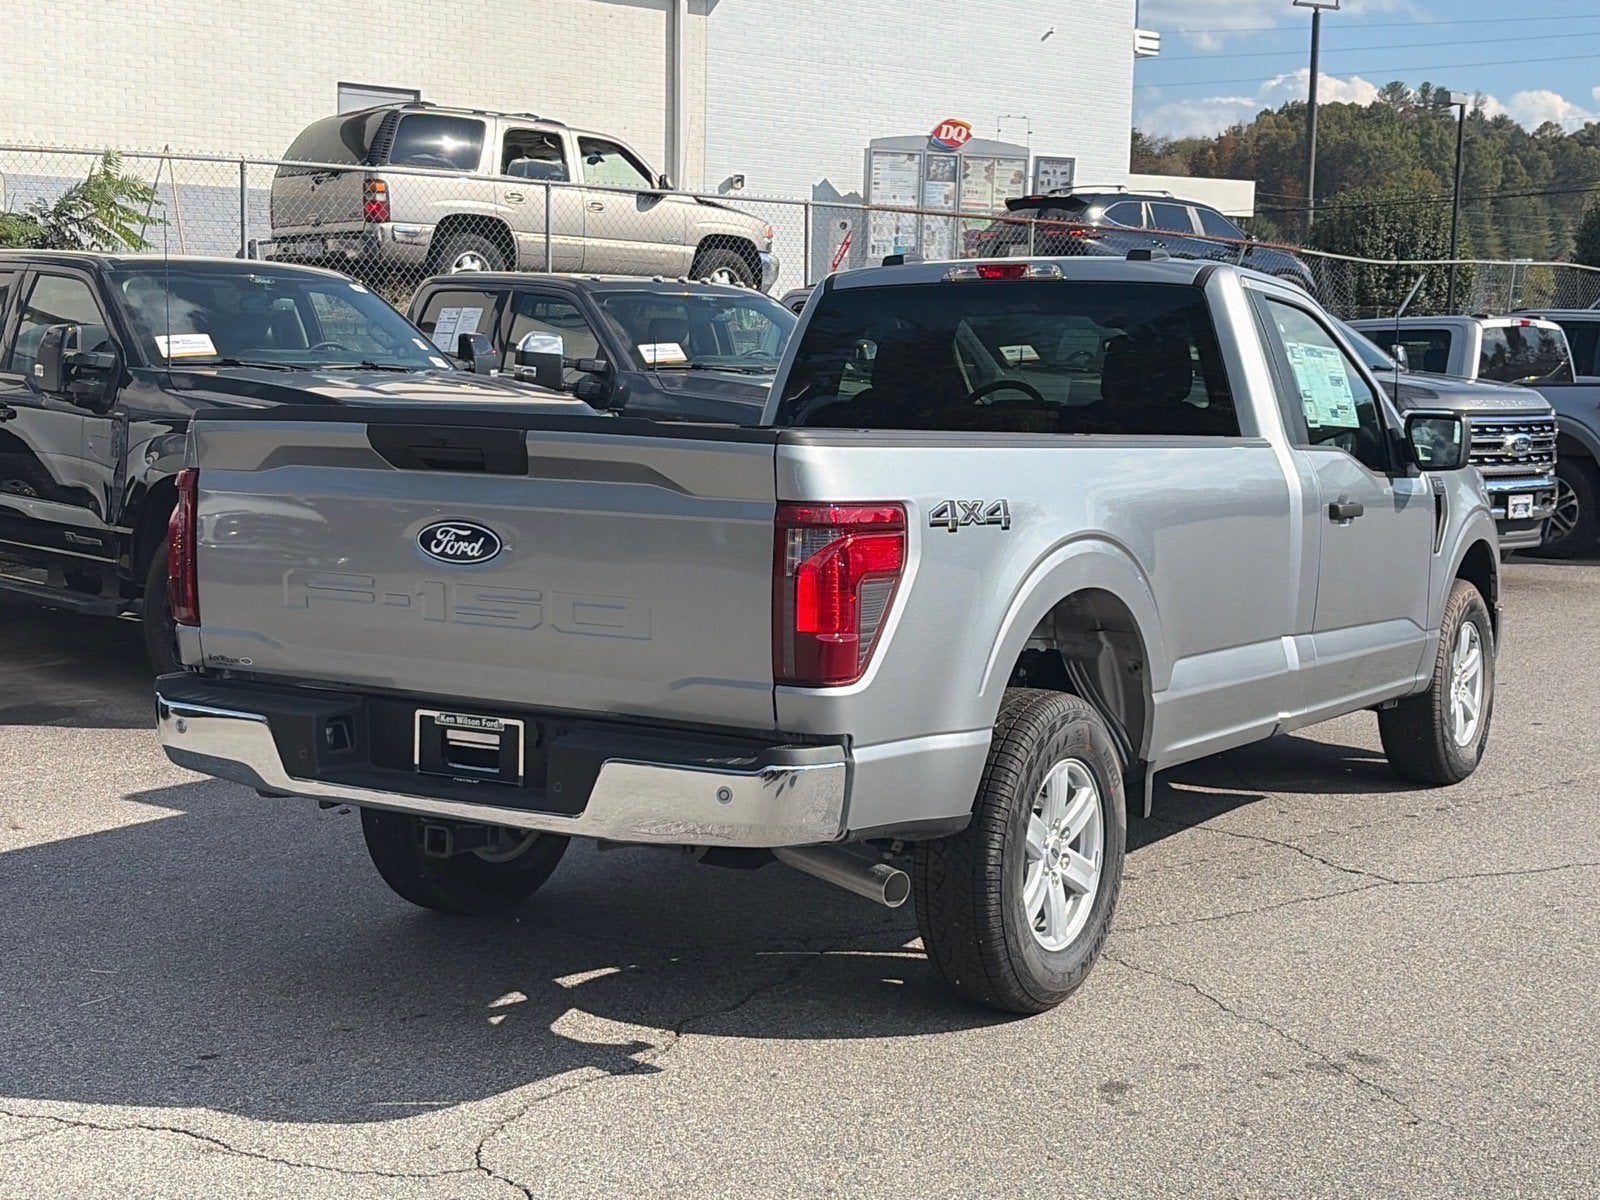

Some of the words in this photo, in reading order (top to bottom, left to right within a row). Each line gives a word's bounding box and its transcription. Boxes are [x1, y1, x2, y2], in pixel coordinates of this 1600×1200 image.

[939, 123, 968, 144] DQ
[430, 526, 486, 557] Ford
[283, 569, 652, 640] F-150
[440, 714, 454, 723] Ken
[456, 716, 480, 726] Wilson
[481, 718, 499, 728] Ford
